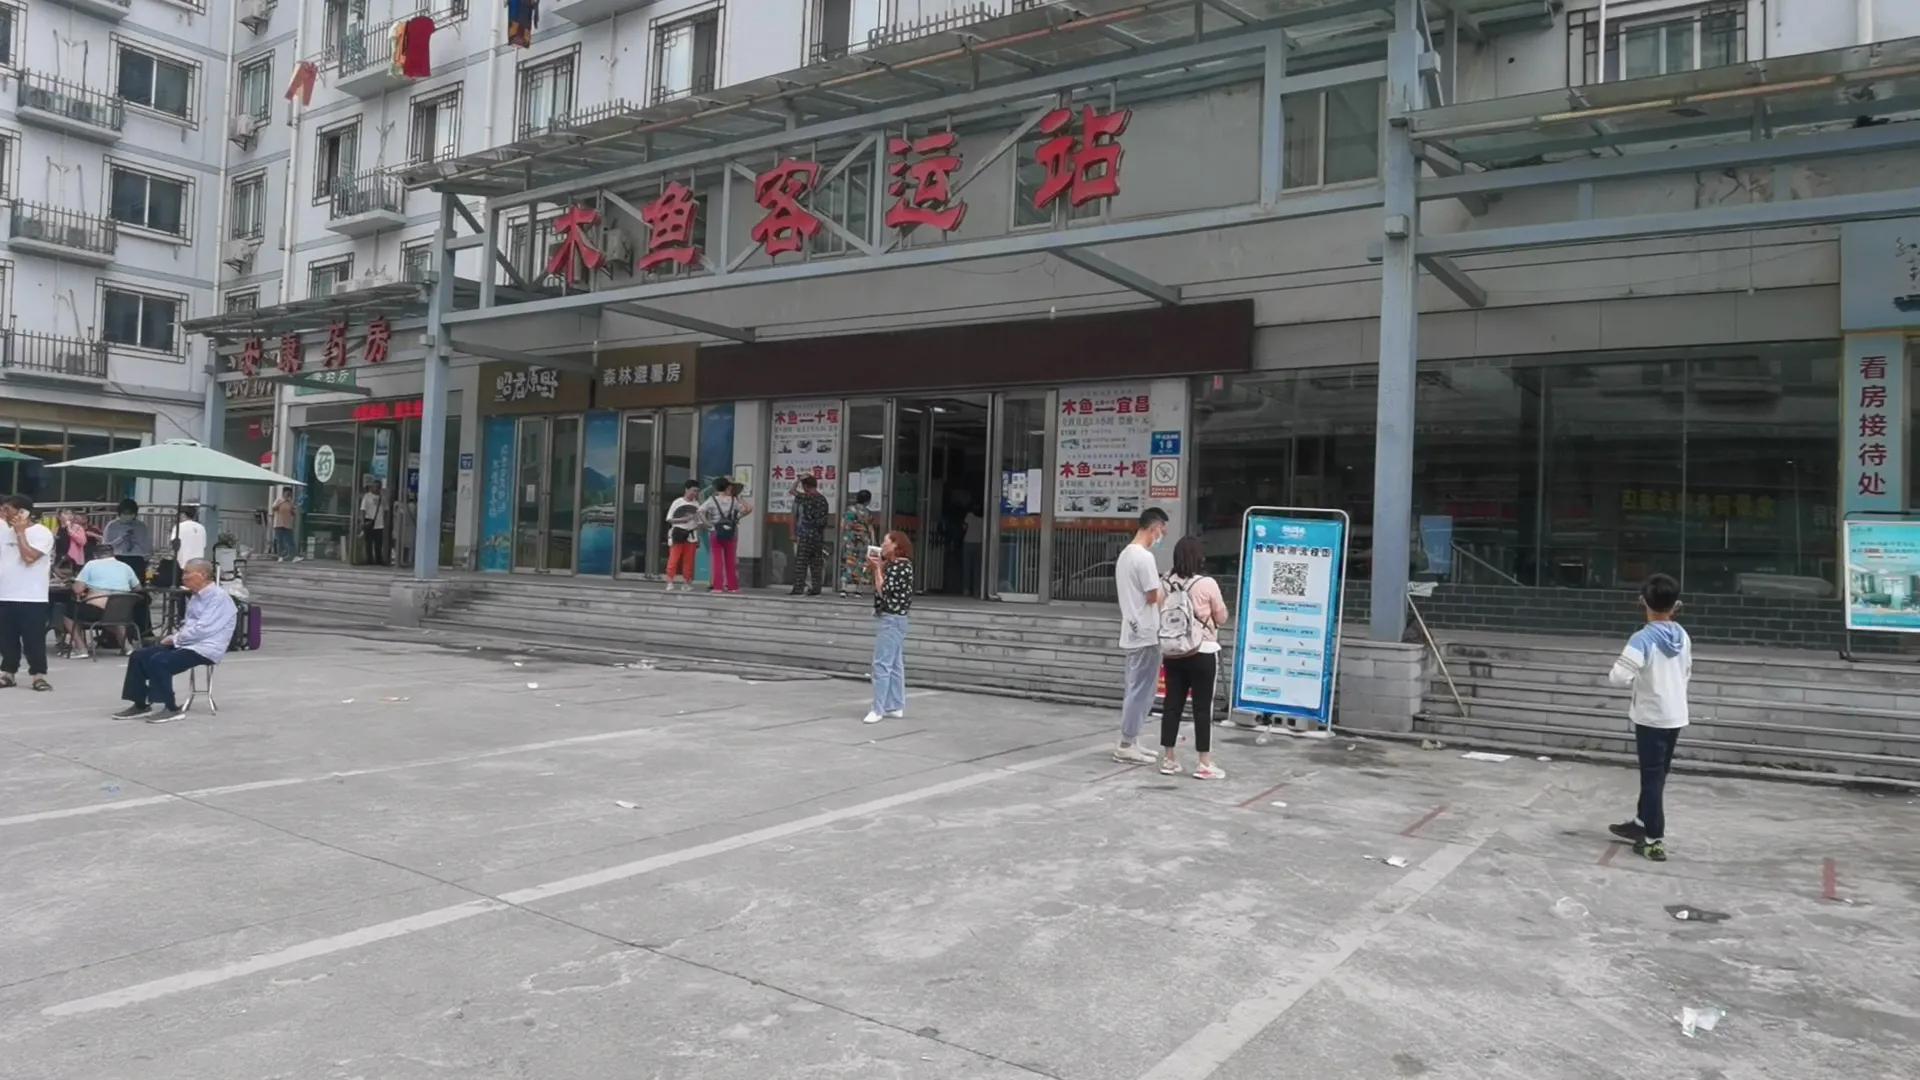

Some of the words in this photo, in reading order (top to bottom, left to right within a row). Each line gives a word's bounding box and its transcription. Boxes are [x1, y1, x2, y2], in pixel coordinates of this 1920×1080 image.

[547, 103, 1133, 287] 木鱼客运站
[603, 362, 681, 387] 森林避暑房
[1062, 398, 1093, 416] 木鱼
[1116, 395, 1149, 414] 宜昌
[775, 410, 798, 425] 木鱼
[1858, 356, 1888, 496] 看房接待处
[772, 465, 795, 480] 木鱼
[1060, 461, 1091, 478] 木鱼
[1114, 460, 1148, 478] 十堰
